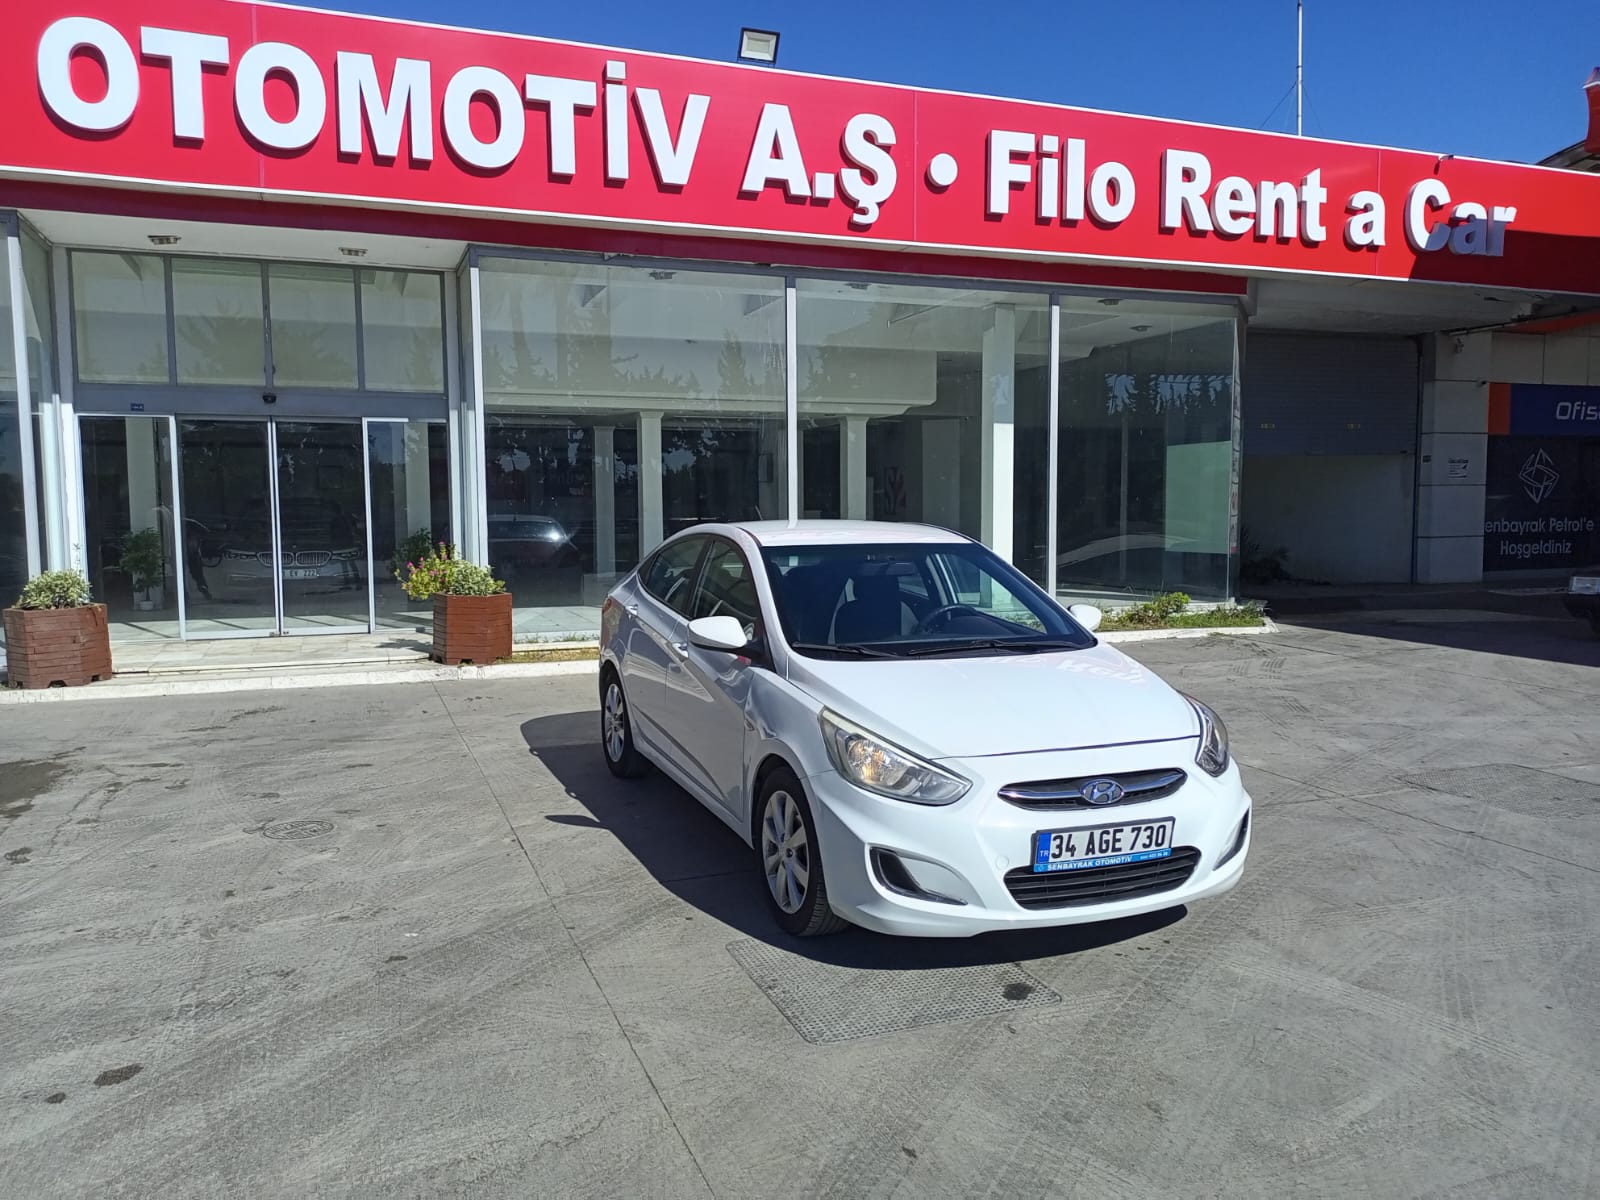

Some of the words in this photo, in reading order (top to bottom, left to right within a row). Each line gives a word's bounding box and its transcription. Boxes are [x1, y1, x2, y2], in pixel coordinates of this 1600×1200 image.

[36, 15, 712, 189] OTOMOTİV
[986, 128, 1137, 225] Filo
[1160, 148, 1328, 244] Rent
[1345, 190, 1387, 248] a
[1405, 178, 1518, 257] Car
[1555, 400, 1600, 421] Ofis
[1485, 517, 1546, 535] enbayrak
[1500, 540, 1572, 559] Hoşgeldiniz
[1039, 850, 1049, 858] TR
[1051, 834, 1076, 860] 34
[1085, 828, 1125, 856] AGE
[1128, 824, 1167, 851] 730
